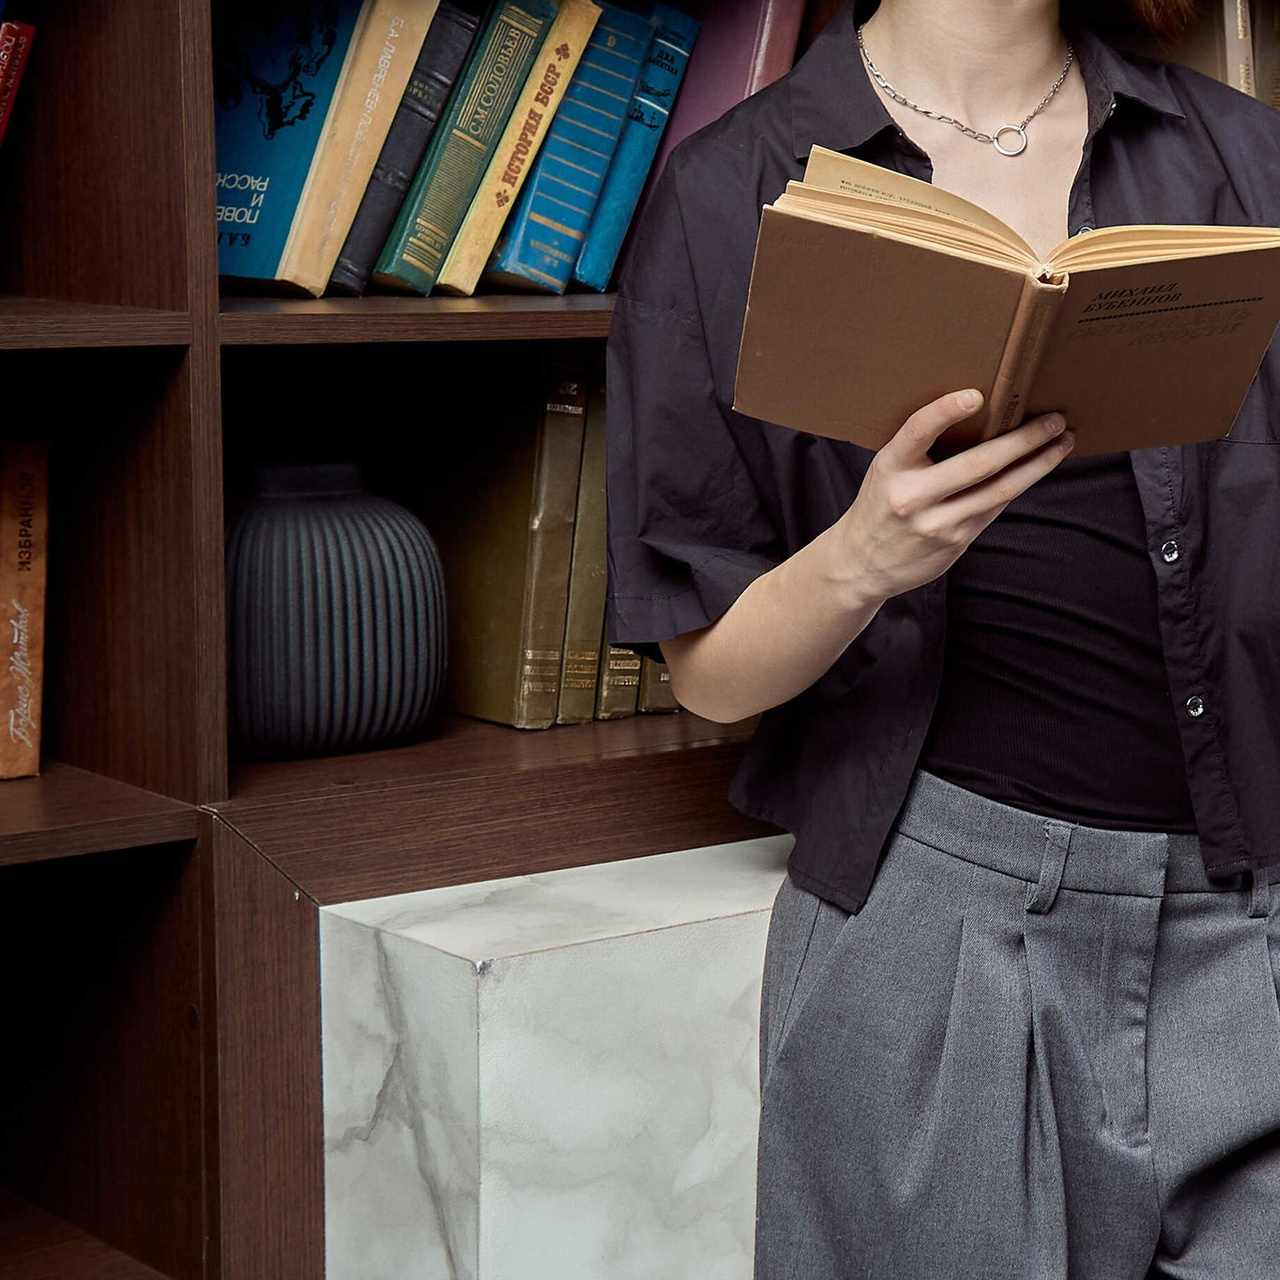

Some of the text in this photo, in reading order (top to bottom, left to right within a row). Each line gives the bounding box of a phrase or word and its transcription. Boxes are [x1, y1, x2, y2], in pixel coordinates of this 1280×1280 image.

[656, 48, 676, 64] ДВА
[499, 62, 563, 187] ИСТОРИЯ БССР
[214, 172, 271, 192] РАССК
[250, 192, 266, 208] И
[215, 206, 261, 225] ПОВЕ
[1092, 283, 1179, 302] МИХАИЛ
[1082, 293, 1183, 314] БУБЕННОВ
[17, 470, 36, 573] ИЗБРАННОЕ
